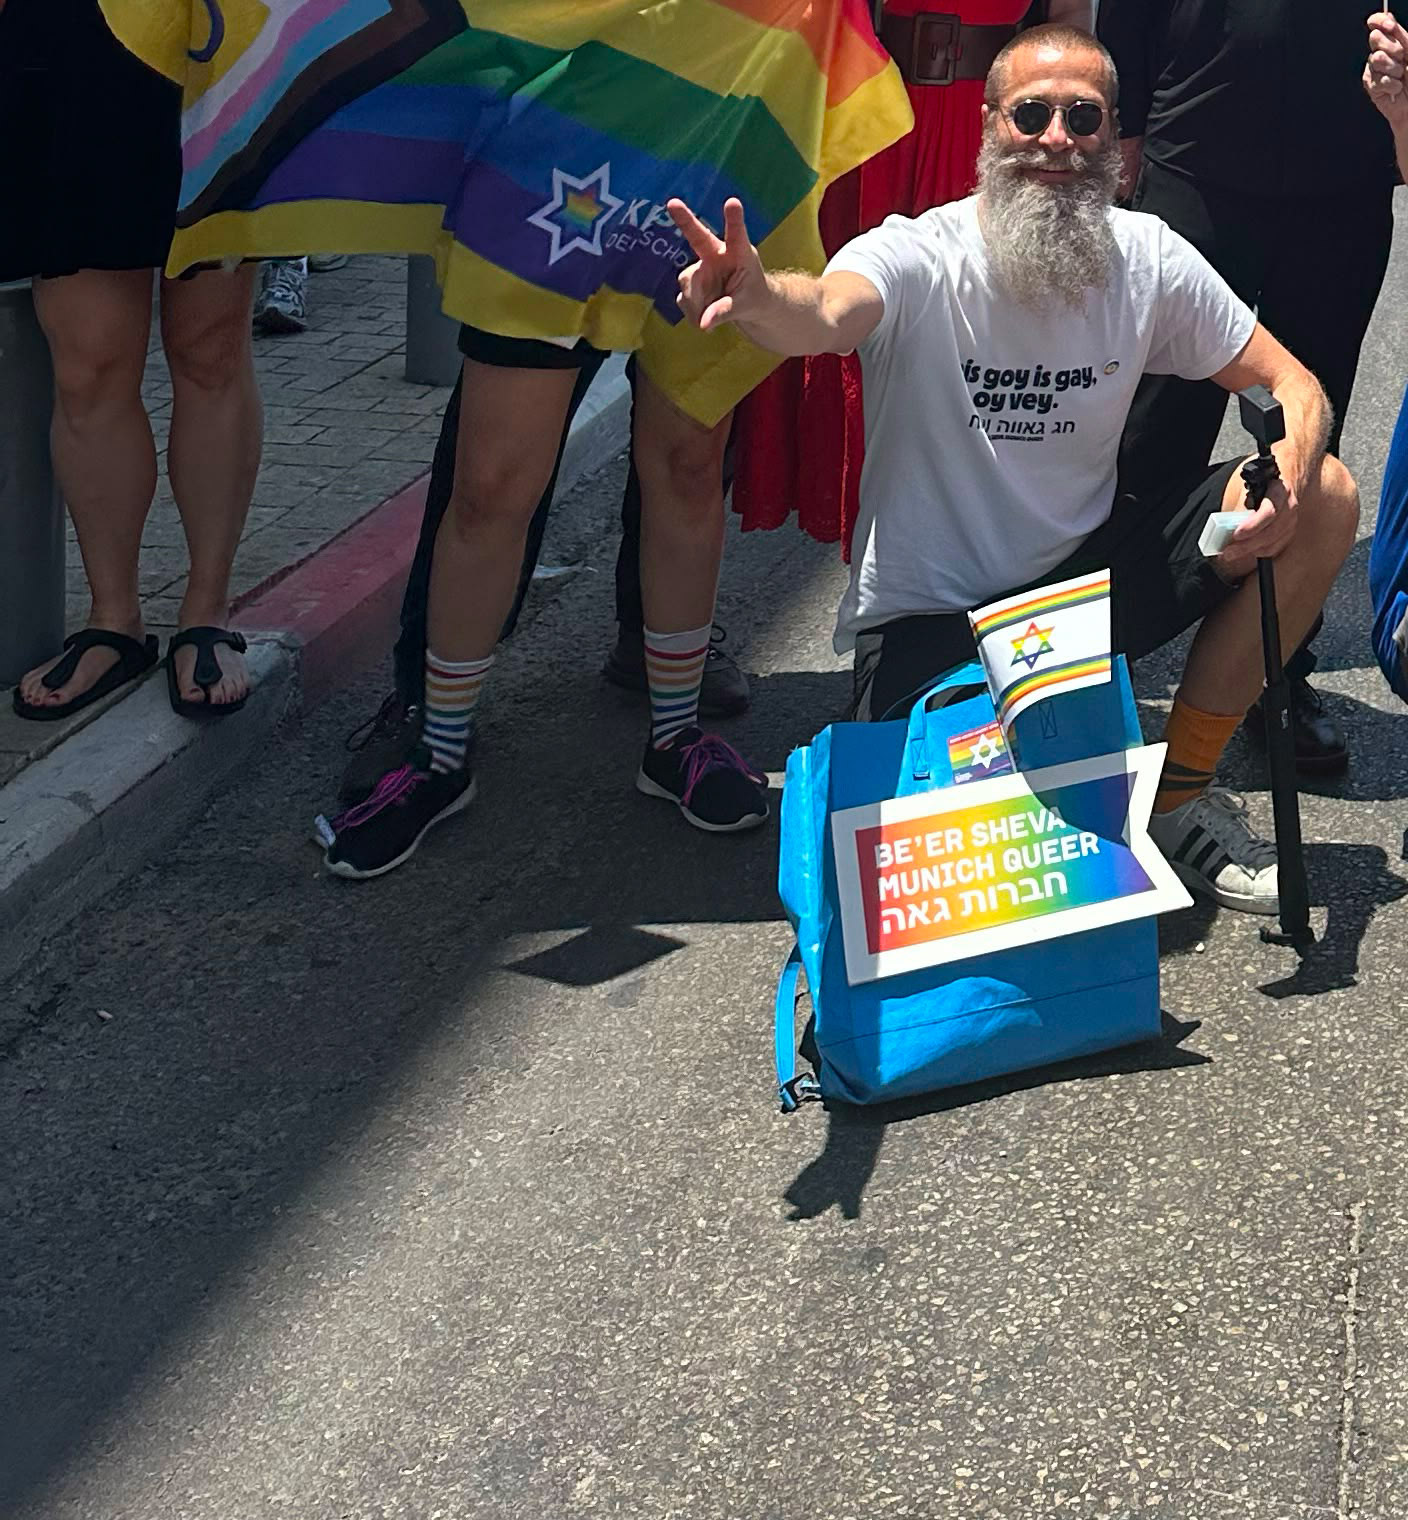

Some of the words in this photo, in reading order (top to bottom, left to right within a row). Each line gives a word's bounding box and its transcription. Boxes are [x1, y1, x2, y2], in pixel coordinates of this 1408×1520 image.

[961, 359, 982, 383] is
[982, 368, 1030, 390] goy
[1032, 365, 1051, 388] is
[1054, 366, 1098, 392] gay,
[973, 391, 1006, 413] oy
[1009, 392, 1059, 415] vey.
[996, 419, 1046, 435] גאווה
[1050, 420, 1076, 434] חג
[970, 806, 1067, 849] SHEVA
[877, 852, 996, 902] MUNICH
[1002, 831, 1101, 873] QUEER
[959, 871, 1069, 917] חברות
[880, 897, 952, 935] גאה
